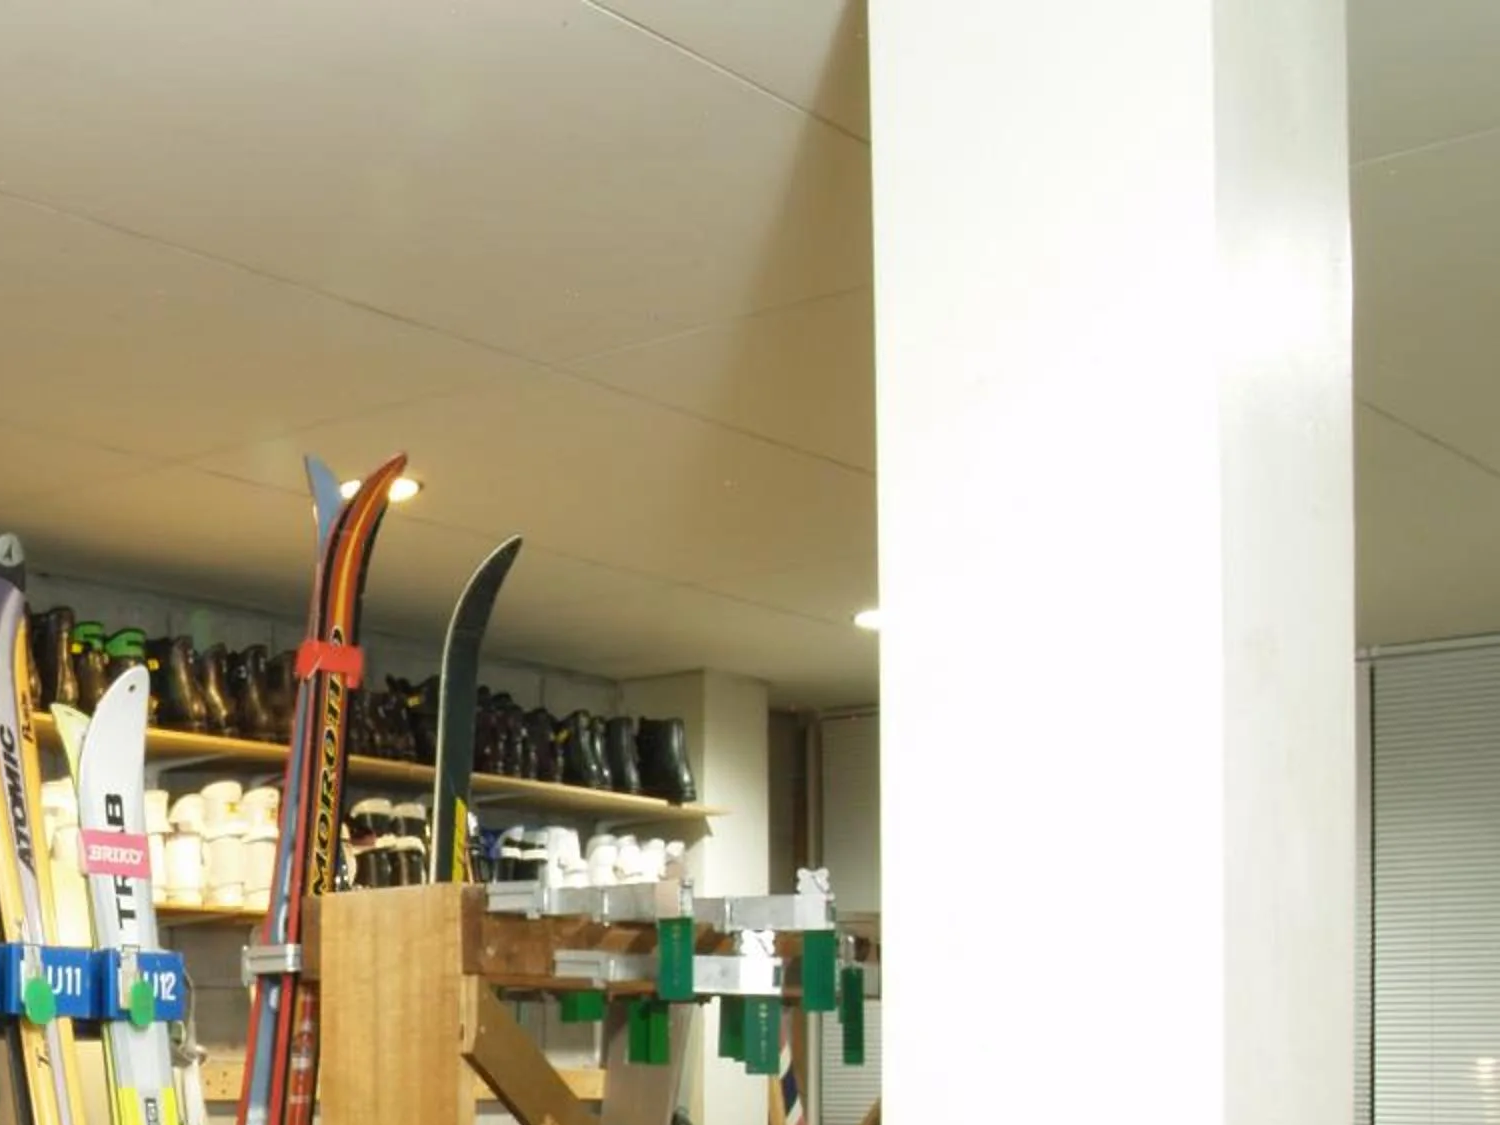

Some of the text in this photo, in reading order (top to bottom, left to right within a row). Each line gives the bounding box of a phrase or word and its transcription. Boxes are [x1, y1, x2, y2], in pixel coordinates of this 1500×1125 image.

[0, 724, 35, 874] ATOMIC
[105, 792, 137, 930] TRB
[47, 966, 83, 997] U11
